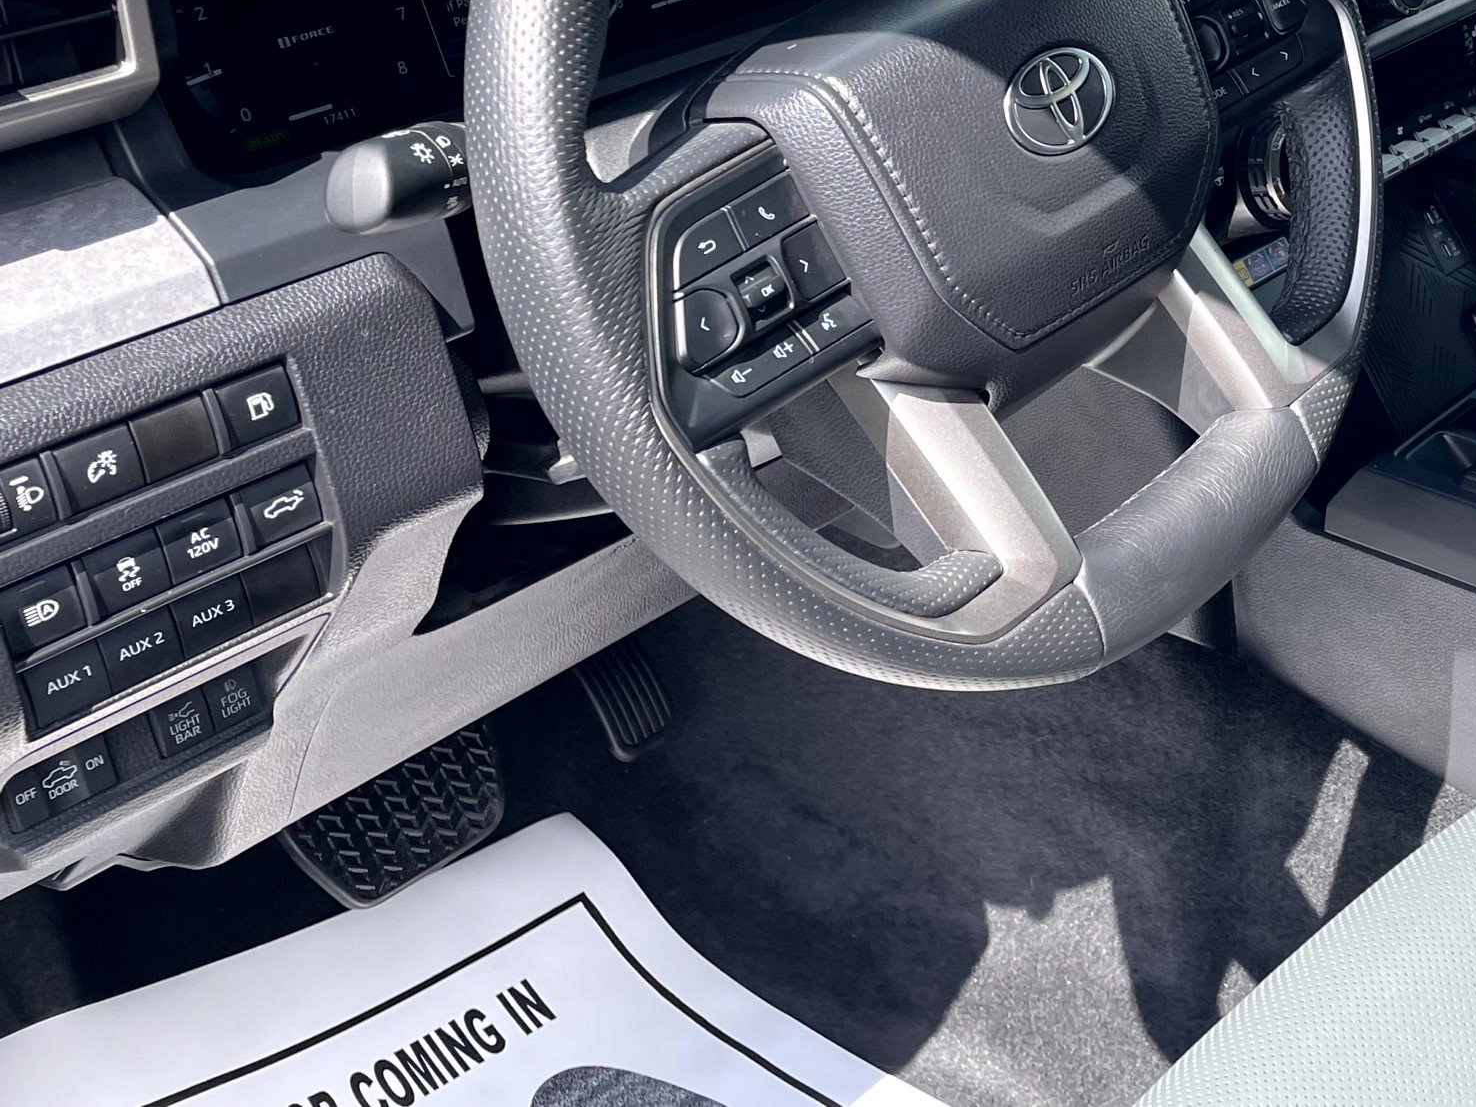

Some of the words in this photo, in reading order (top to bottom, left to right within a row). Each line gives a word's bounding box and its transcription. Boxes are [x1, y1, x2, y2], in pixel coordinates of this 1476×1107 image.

[194, 6, 208, 22] 2
[395, 5, 407, 22] 7
[397, 60, 409, 75] 8
[1212, 86, 1229, 100] ODE
[239, 107, 252, 123] 0
[322, 107, 357, 126] 17411
[1071, 270, 1098, 296] SRS
[1102, 234, 1150, 277] AIRBAG
[761, 284, 775, 297] OK
[191, 528, 211, 543] AC
[187, 538, 220, 560] 120V
[121, 575, 143, 592] OFF
[192, 604, 223, 628] AUX
[226, 599, 236, 615] 3
[119, 637, 152, 662] AUX
[155, 632, 165, 647] 2
[46, 671, 81, 696] AUX
[84, 664, 93, 680] 1
[221, 689, 248, 708] FOG
[222, 697, 252, 719] LIGHT
[169, 713, 201, 737] LIGHT
[175, 724, 202, 745] BAR
[85, 755, 105, 771] ON
[15, 787, 38, 807] OFF
[48, 778, 79, 801] DOOR
[349, 1008, 507, 1107] COMING
[496, 979, 557, 1036] IN
